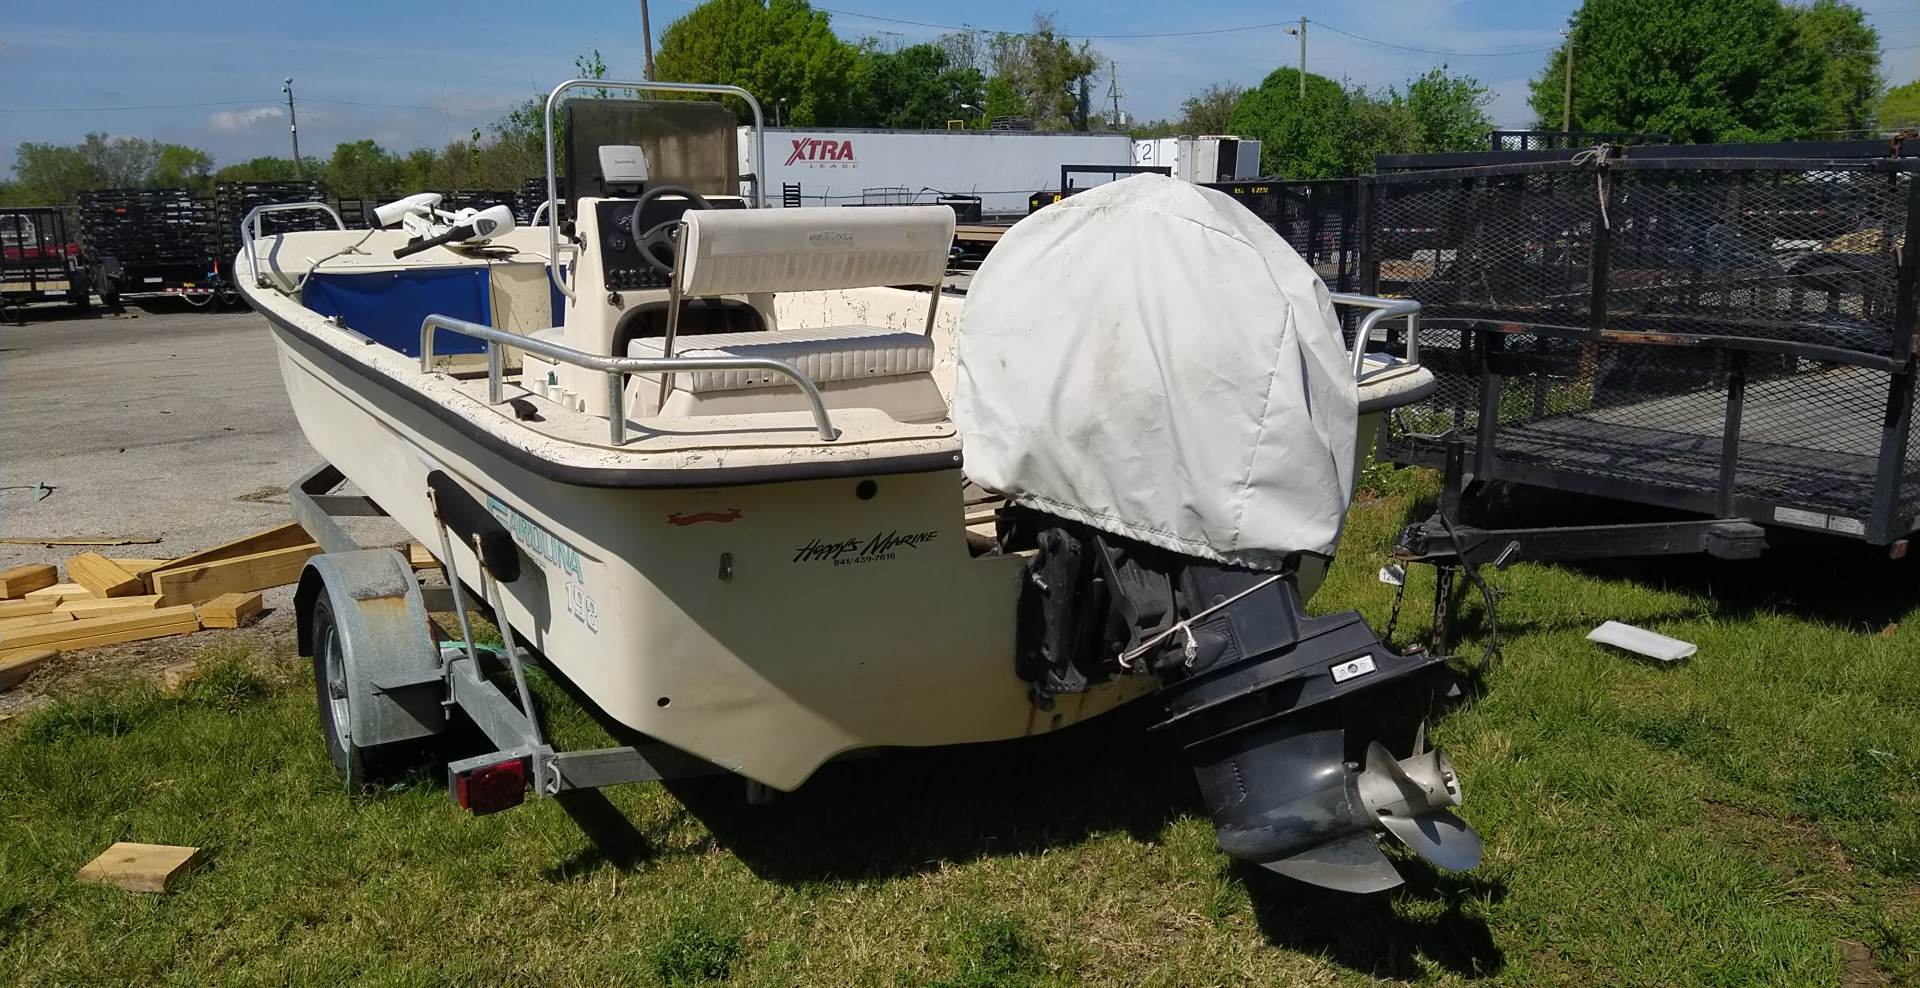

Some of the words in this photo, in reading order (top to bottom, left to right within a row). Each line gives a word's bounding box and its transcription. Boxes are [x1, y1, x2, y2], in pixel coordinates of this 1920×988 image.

[784, 138, 854, 166] XTRA
[1142, 143, 1152, 160] 2
[565, 581, 598, 634] 198
